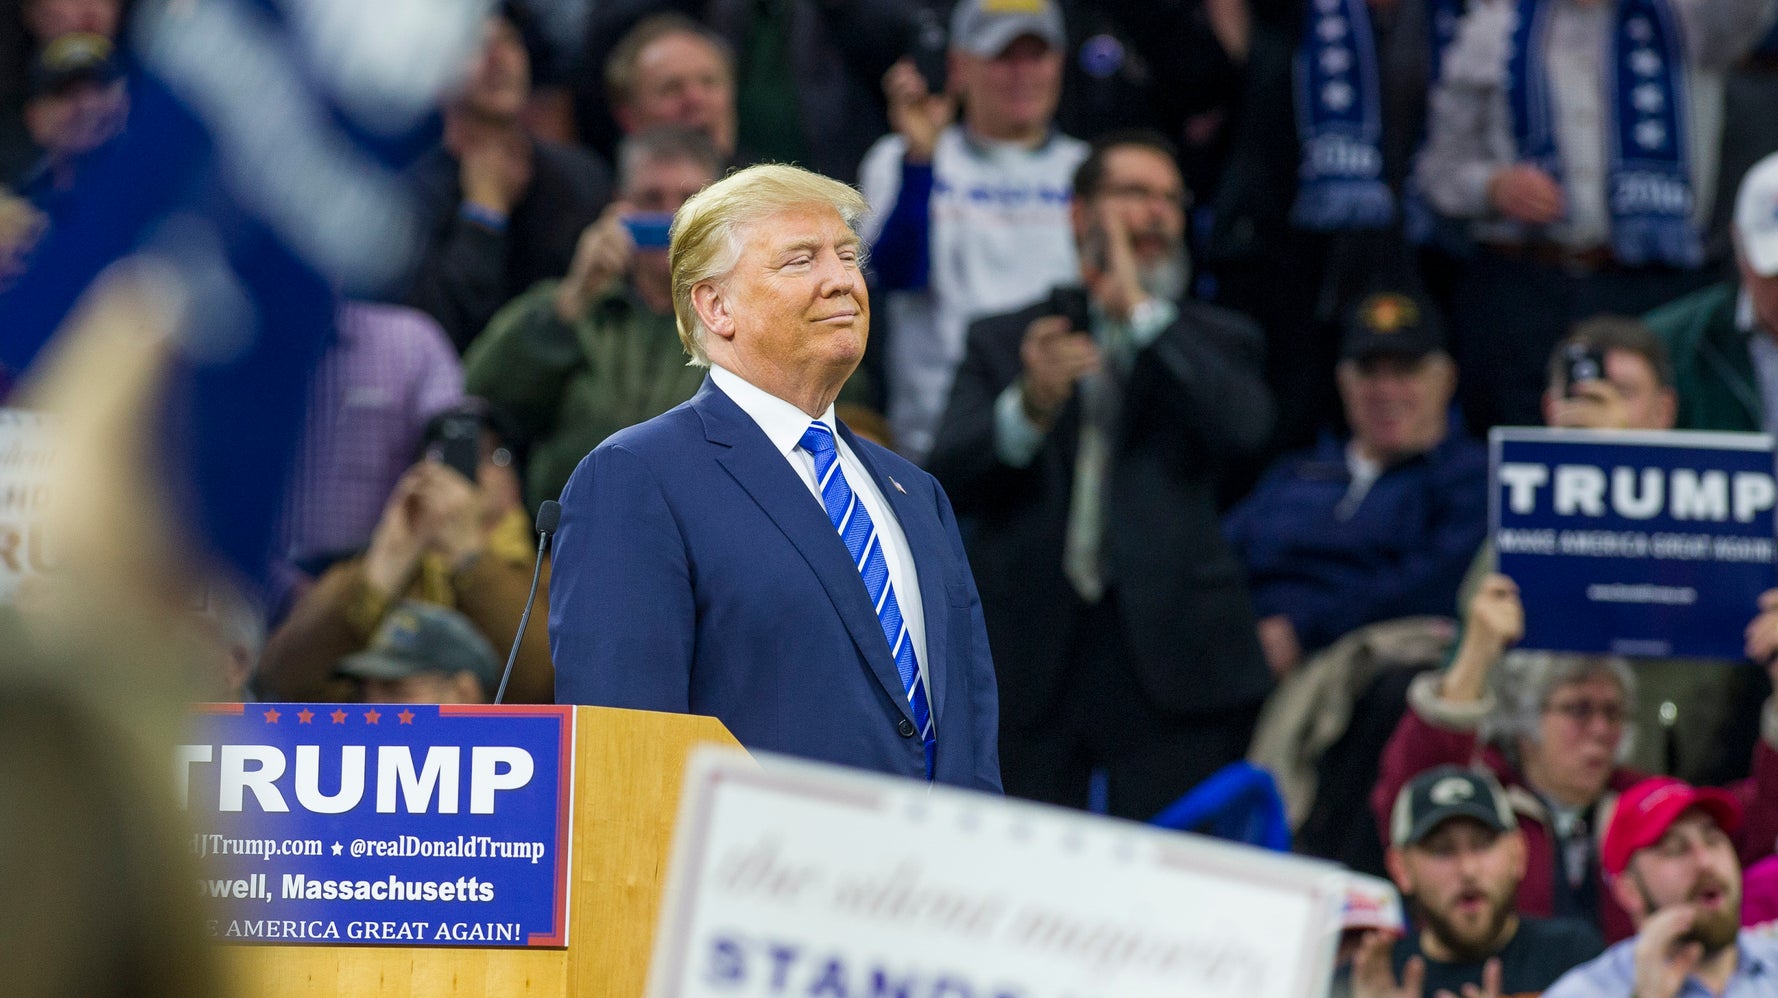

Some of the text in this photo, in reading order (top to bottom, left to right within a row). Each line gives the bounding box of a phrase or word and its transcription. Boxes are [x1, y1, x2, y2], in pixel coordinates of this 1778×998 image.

[1498, 463, 1777, 523] TRUMP
[1557, 530, 1648, 558] AMERICA
[174, 744, 535, 815] TRUMP
[350, 835, 545, 864] @realDonaldTrump
[281, 873, 494, 902] Massachusetts
[225, 919, 340, 939] AMERICA
[346, 921, 428, 940] GREAT
[434, 922, 521, 941] AGAIN!
